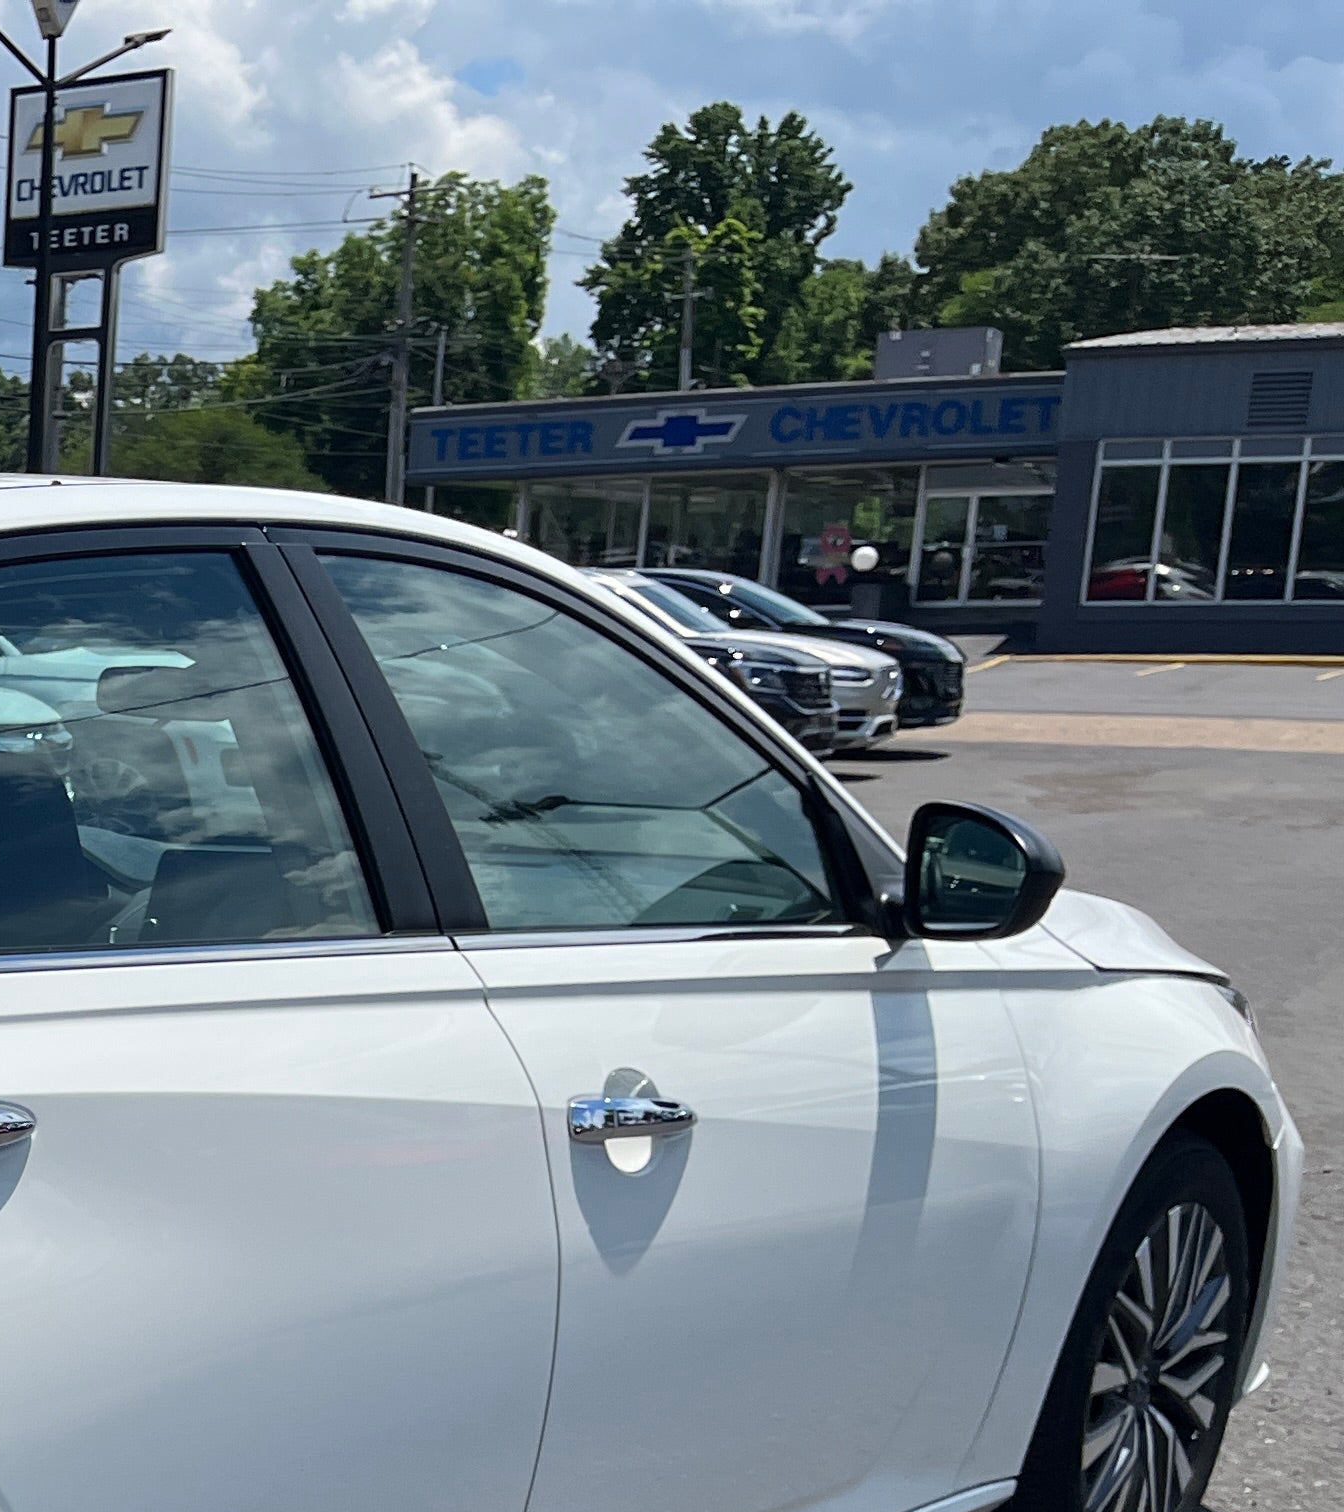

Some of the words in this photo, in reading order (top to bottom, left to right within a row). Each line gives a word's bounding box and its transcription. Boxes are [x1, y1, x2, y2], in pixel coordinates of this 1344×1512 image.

[28, 223, 130, 251] TEETER
[430, 421, 594, 461] TEETER
[769, 397, 1061, 444] CHEVROLET
